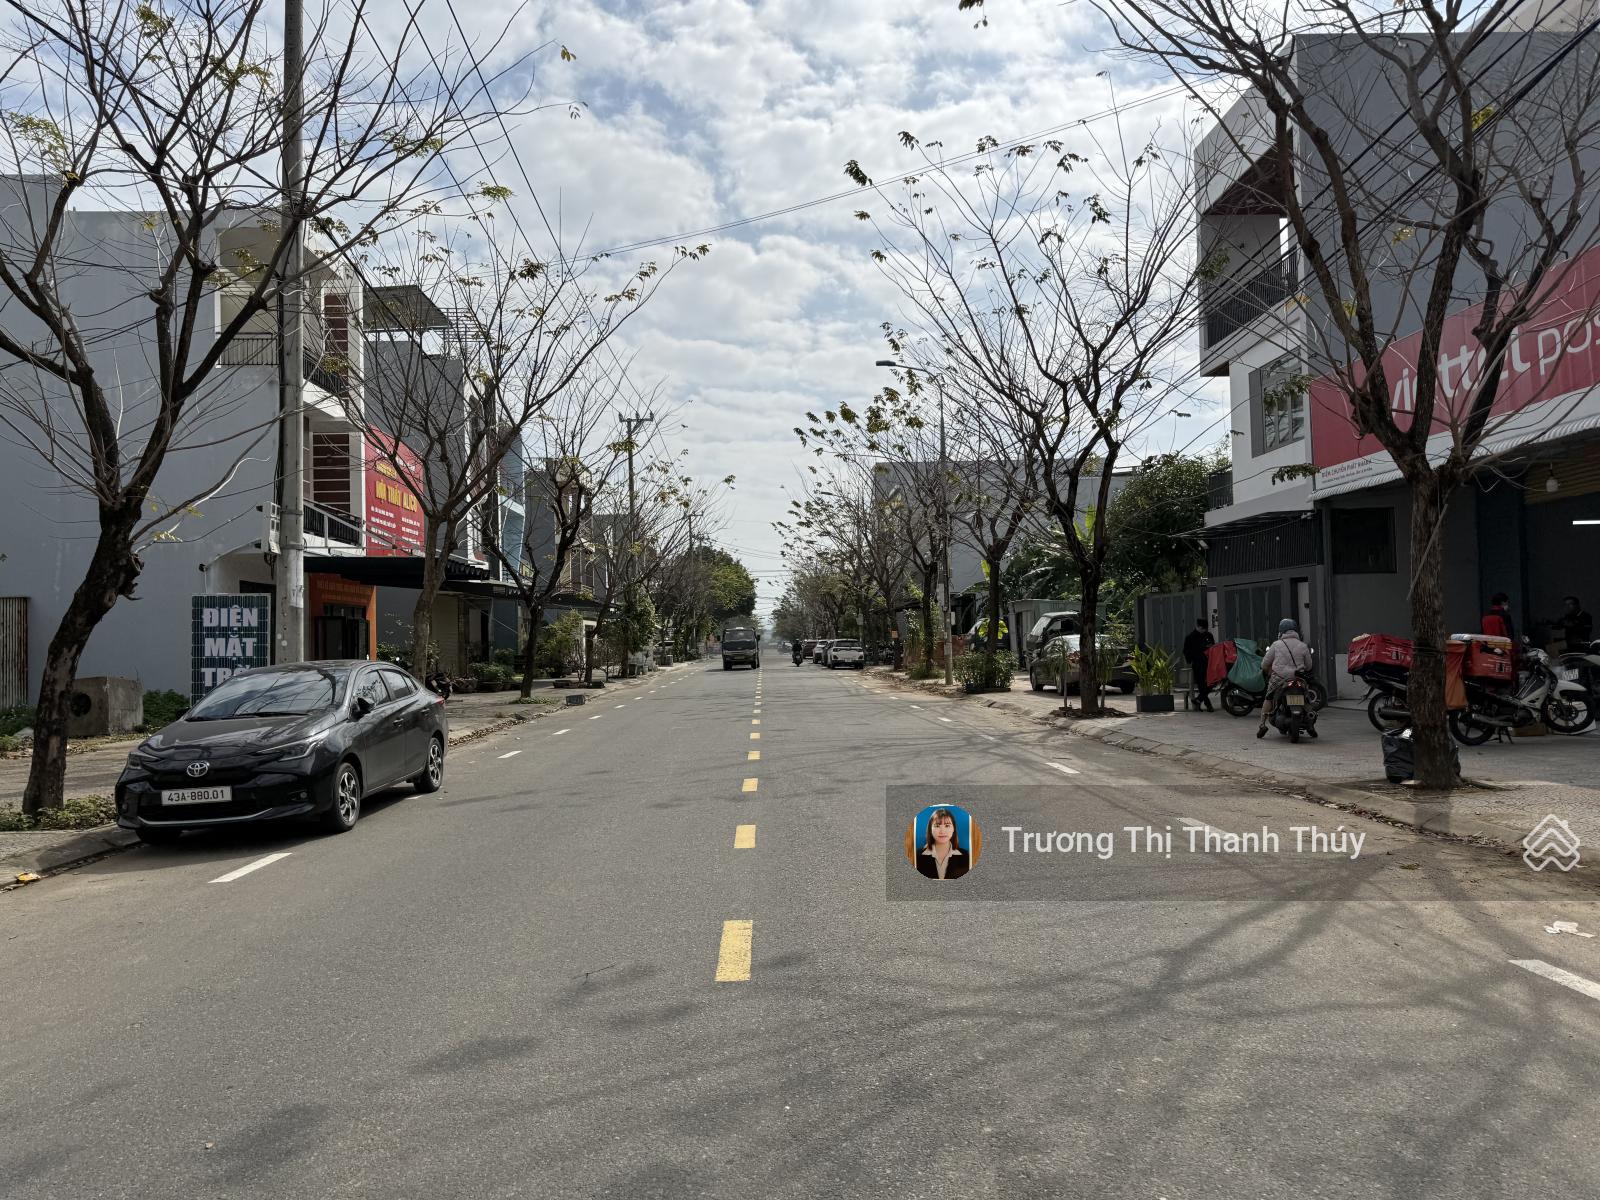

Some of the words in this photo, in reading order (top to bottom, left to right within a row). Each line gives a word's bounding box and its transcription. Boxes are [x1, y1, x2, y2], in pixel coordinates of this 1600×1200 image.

[202, 604, 259, 631] ĐIỆN
[204, 633, 257, 661] MẶT
[167, 789, 225, 802] 43A-880.01
